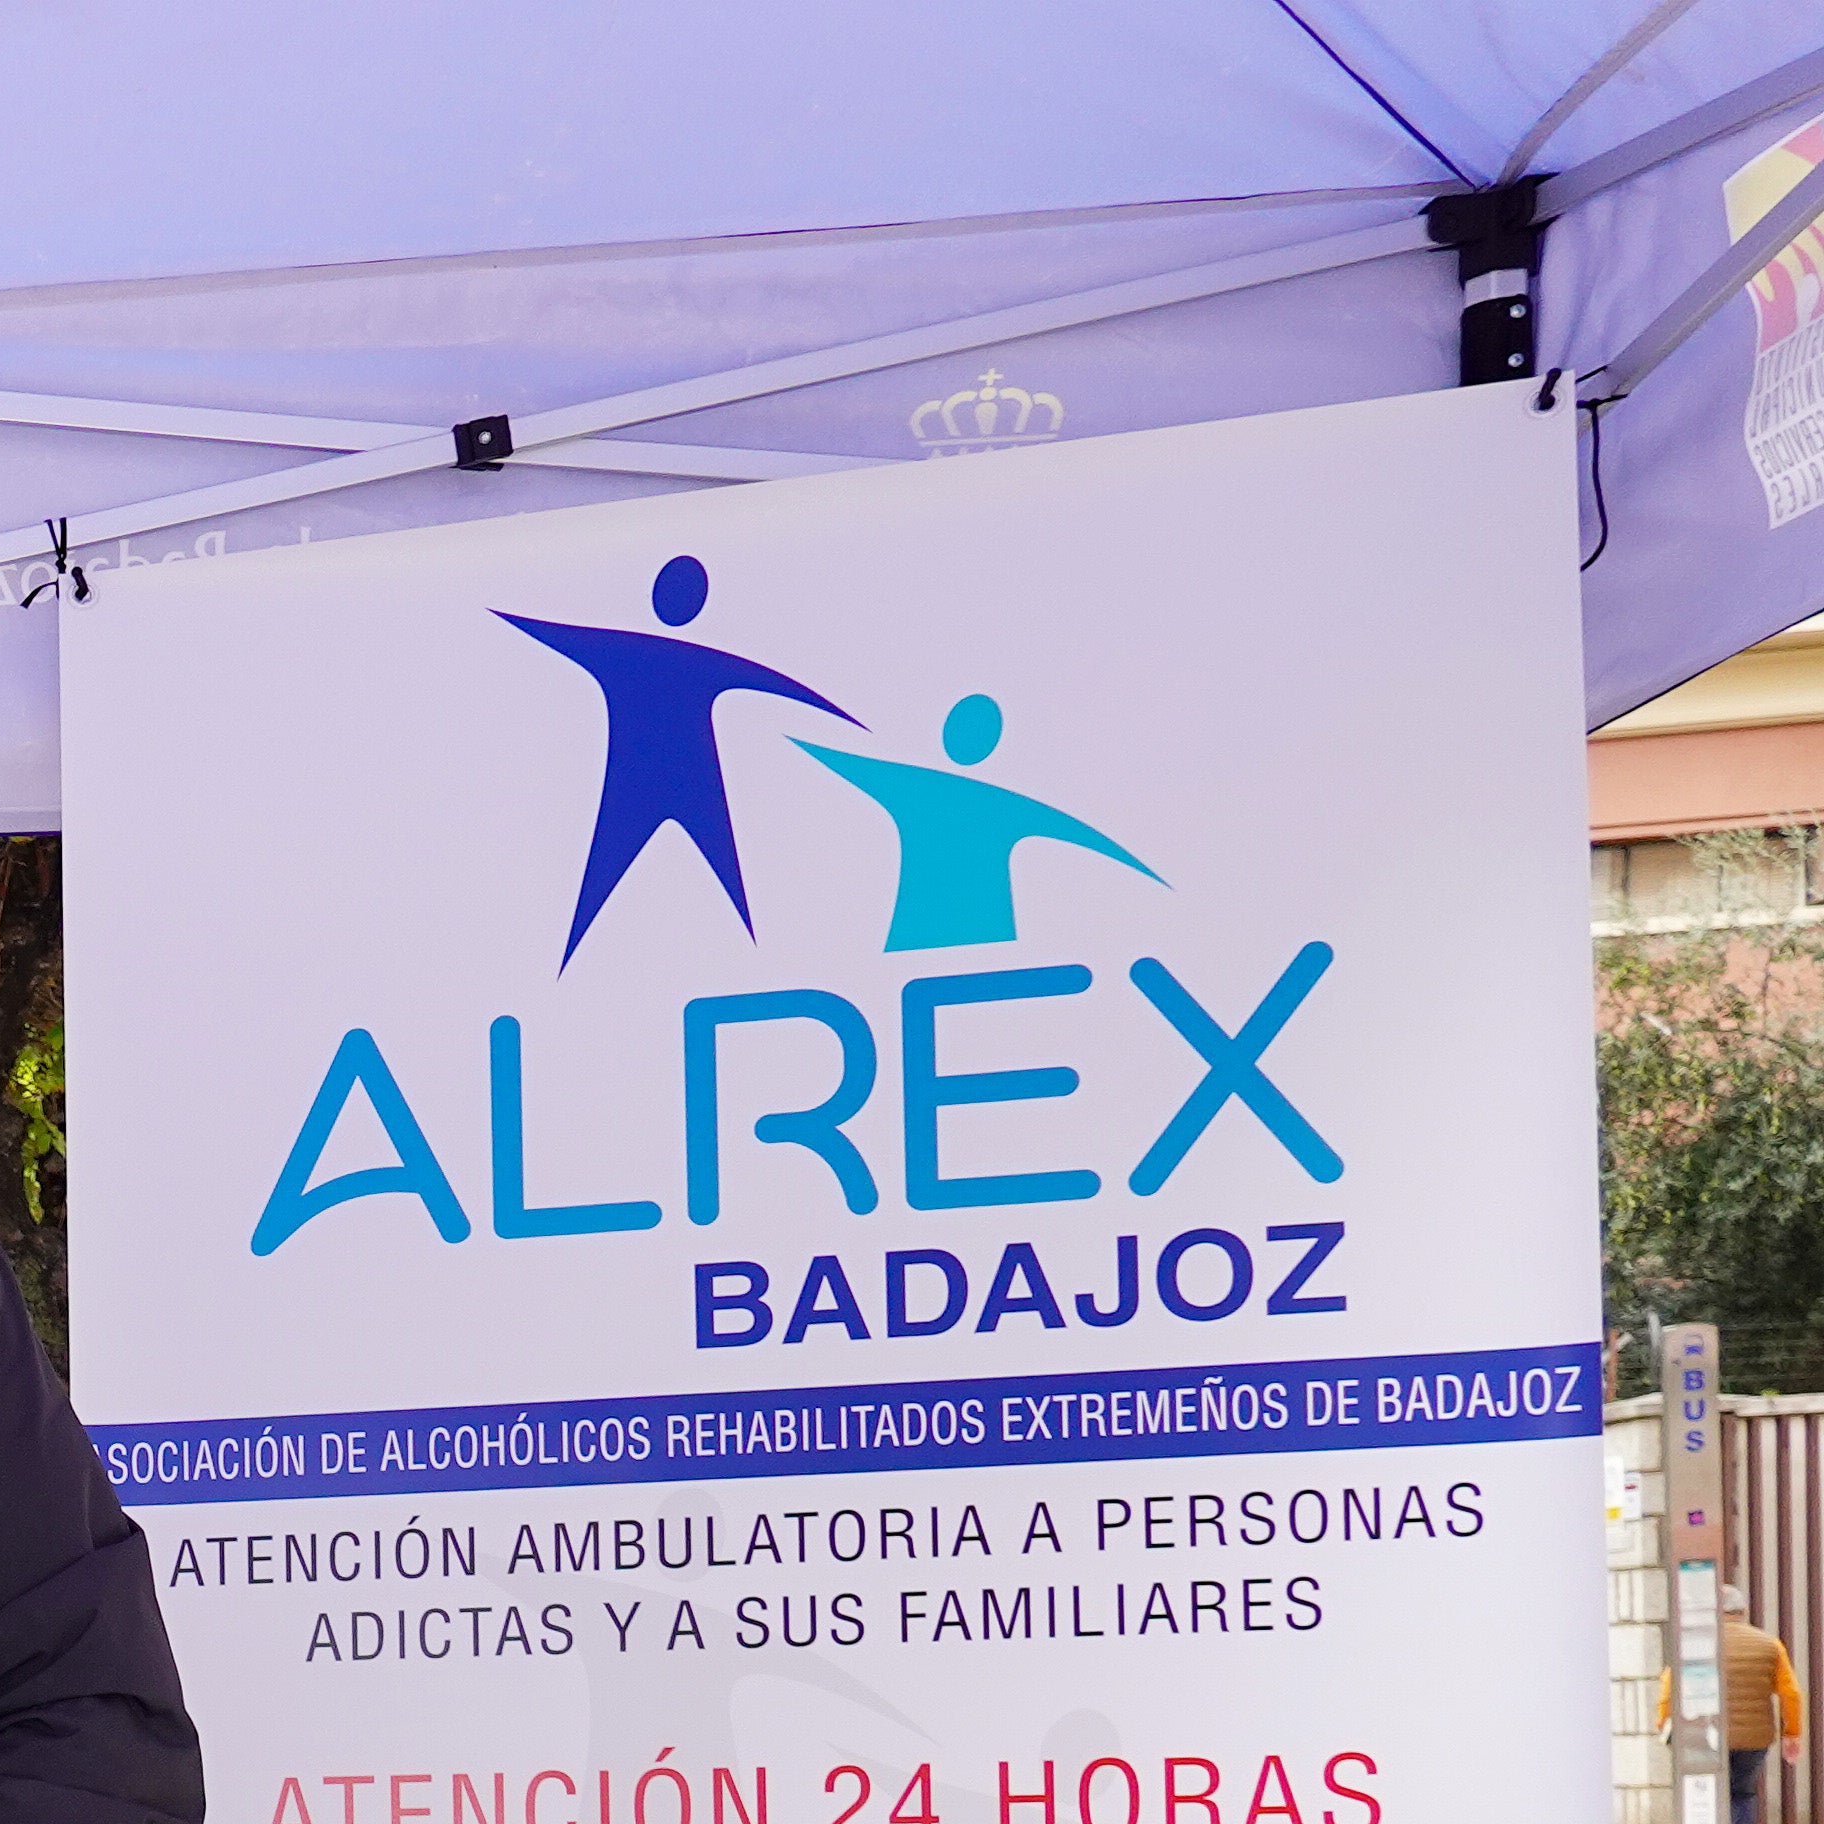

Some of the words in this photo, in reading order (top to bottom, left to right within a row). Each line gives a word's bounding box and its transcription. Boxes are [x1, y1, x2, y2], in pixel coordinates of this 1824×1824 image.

[249, 939, 1346, 1258] ALREX
[692, 1220, 1350, 1352] BADAJOZ
[320, 1431, 367, 1476] DE
[379, 1412, 651, 1473] ALCOHÓLICOS
[666, 1396, 986, 1460] REHABILITADOS
[1000, 1375, 1289, 1443] EXTREMEÑOS
[1304, 1377, 1360, 1427] DE
[1376, 1365, 1582, 1424] BADAJOZ
[1684, 1369, 1705, 1451] BUS
[168, 1515, 477, 1589] ATENCIÓN
[507, 1503, 992, 1575] AMBULATORIA
[1021, 1501, 1063, 1555] A
[1097, 1482, 1486, 1552] PERSONAS
[305, 1602, 574, 1663] ADICTAS
[604, 1601, 640, 1651] Y
[666, 1600, 706, 1651] A
[735, 1592, 865, 1649] SUS
[899, 1575, 1324, 1643] FAMILIARES
